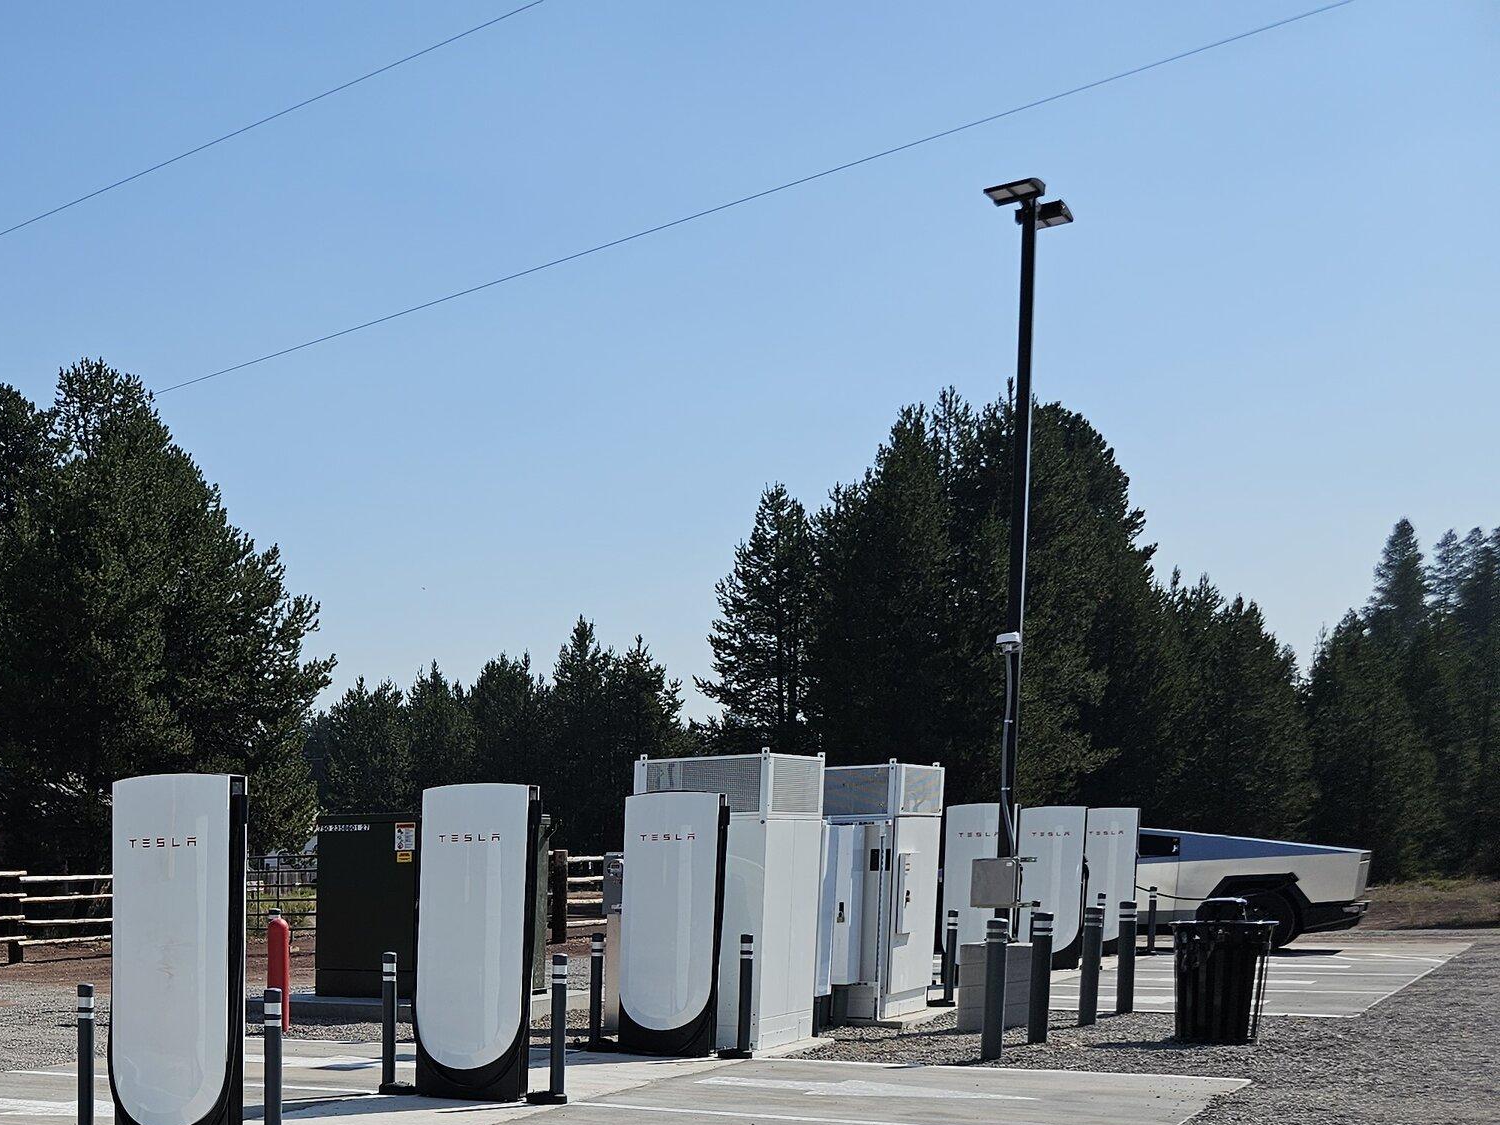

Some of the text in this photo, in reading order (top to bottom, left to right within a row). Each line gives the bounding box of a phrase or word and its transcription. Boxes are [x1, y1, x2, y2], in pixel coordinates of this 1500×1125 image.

[439, 833, 500, 842] TESLA
[640, 833, 695, 841] TESLA
[129, 837, 197, 848] TESLA
